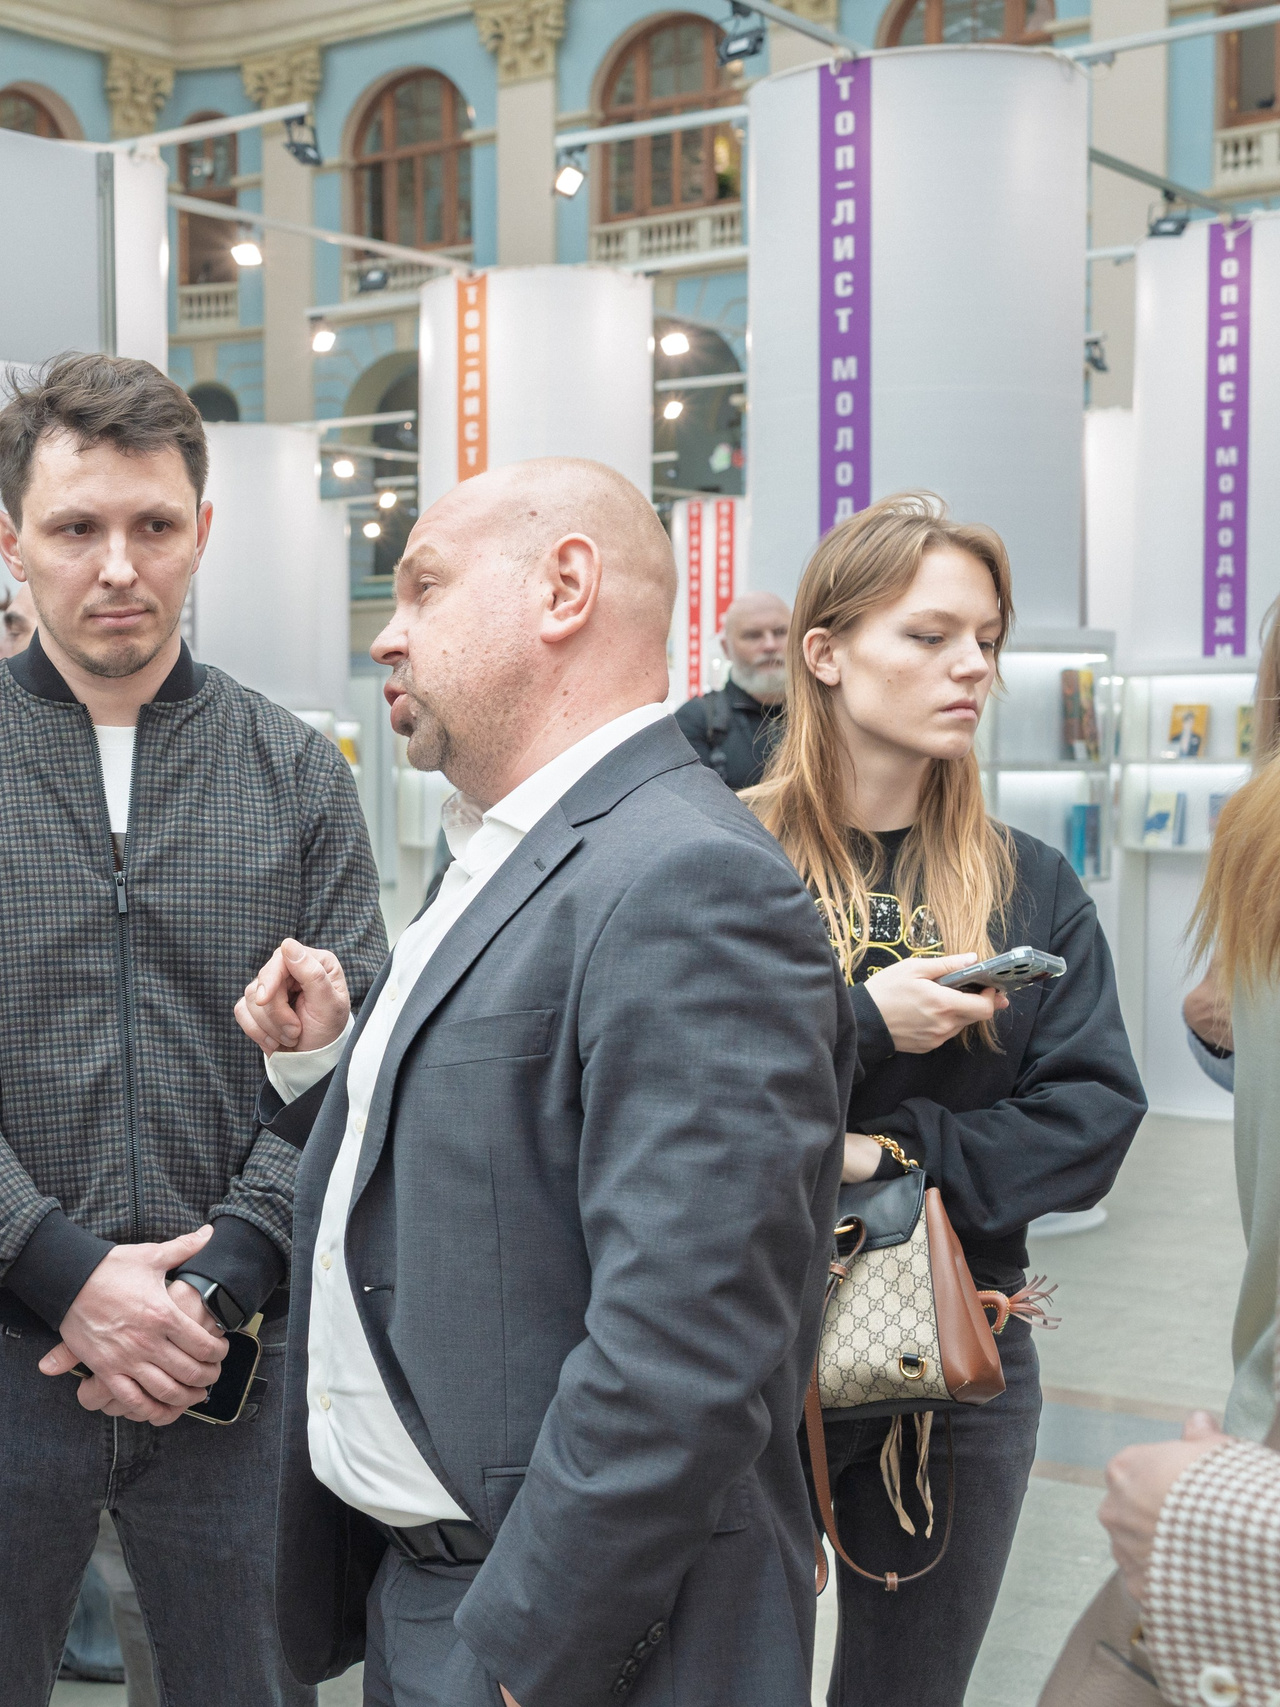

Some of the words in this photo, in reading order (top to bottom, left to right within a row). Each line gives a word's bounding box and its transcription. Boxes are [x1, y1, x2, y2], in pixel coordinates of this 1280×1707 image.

[831, 76, 855, 333] ТОП-ЛИСТ
[463, 285, 480, 467] ТОП-ЛИСТ
[1217, 229, 1239, 431] ТОП-ЛИСТ
[832, 356, 857, 526] МОЛОД
